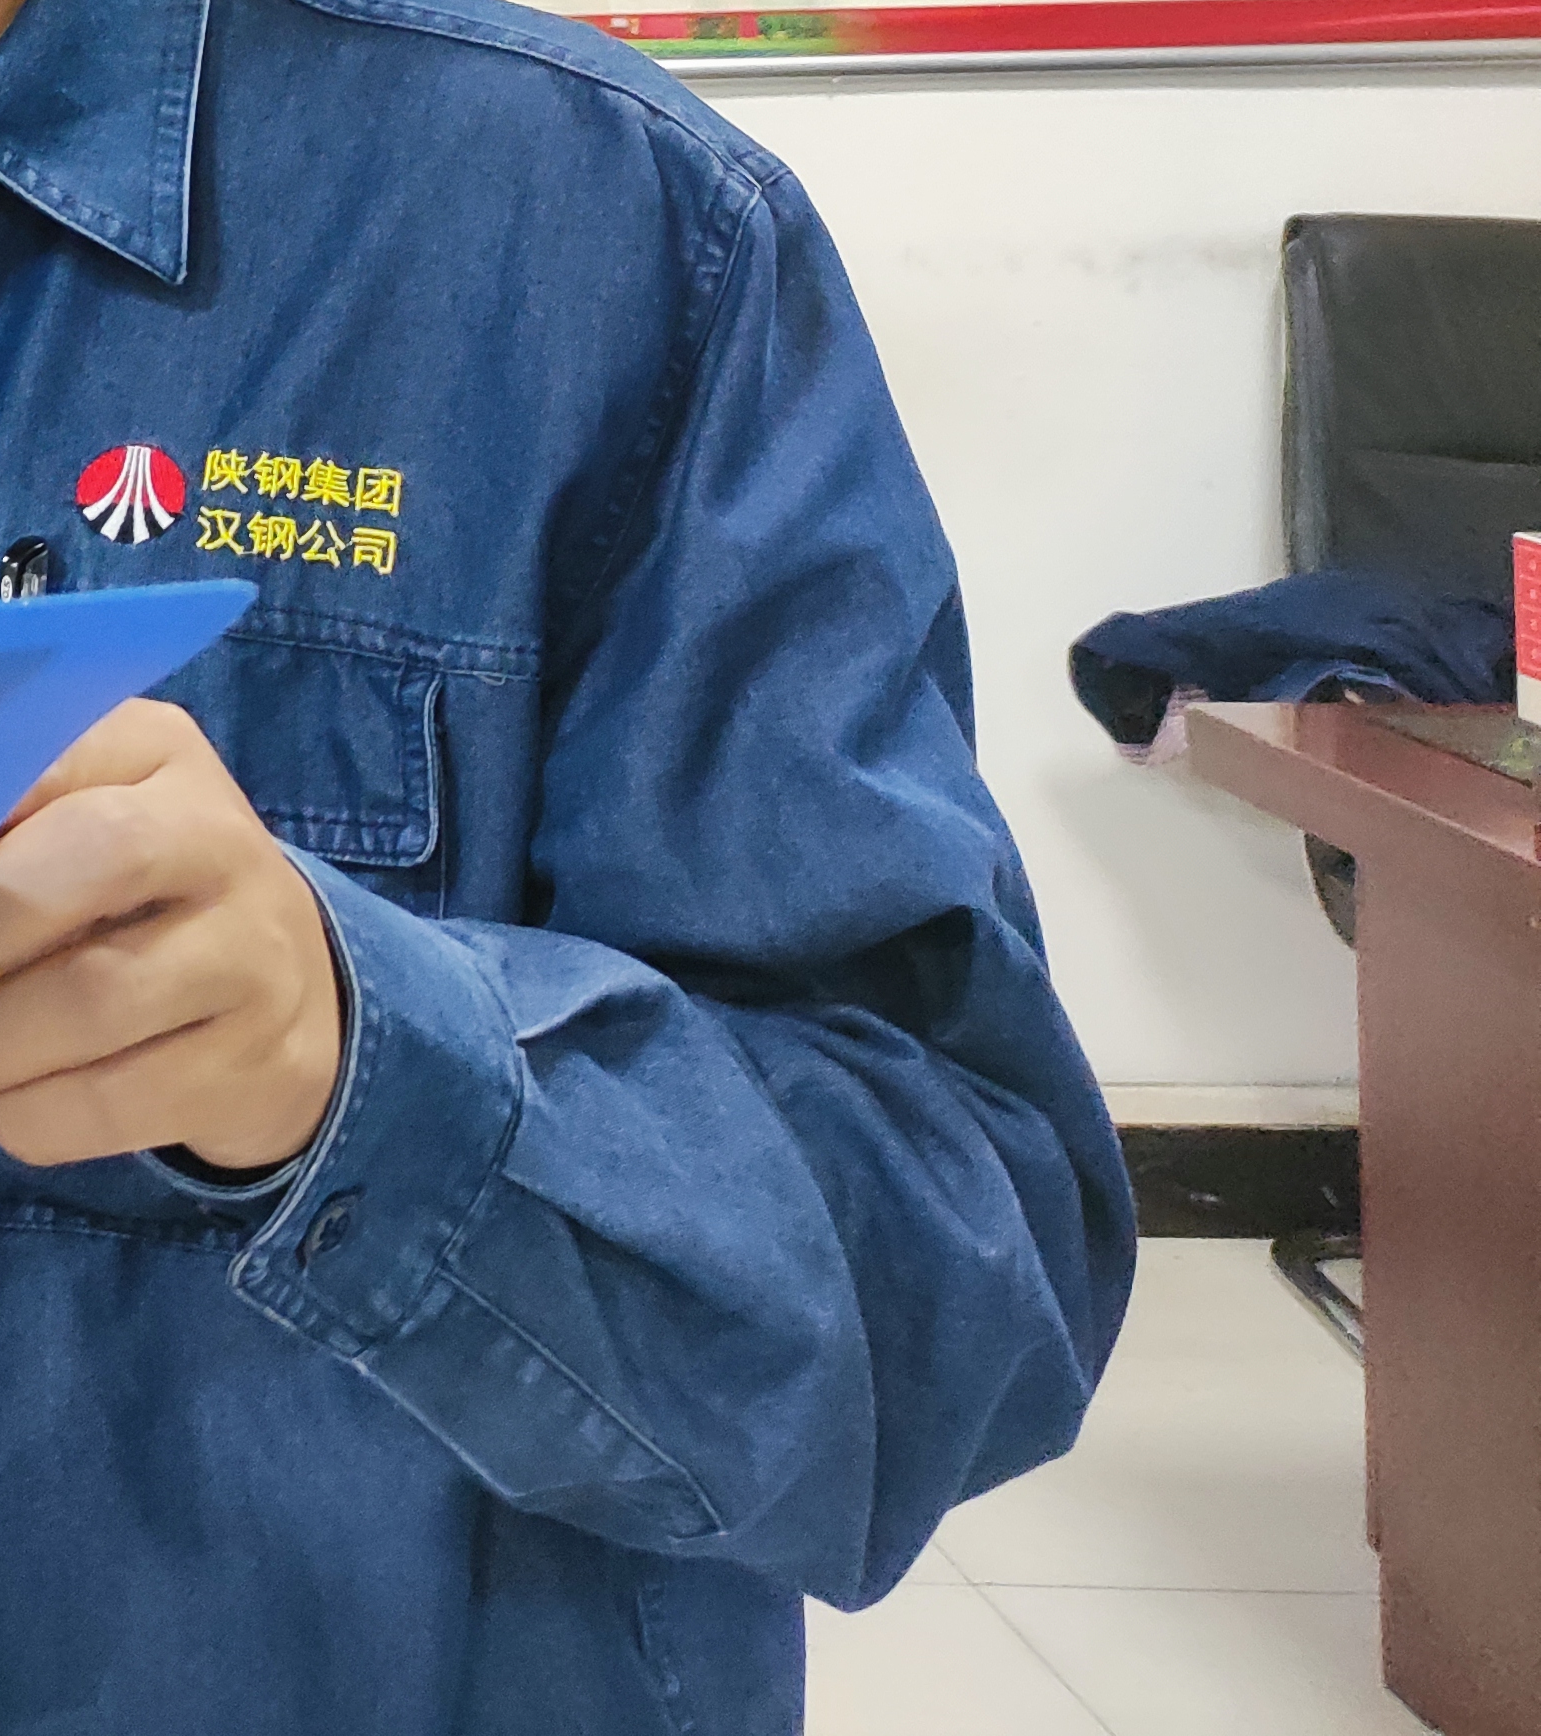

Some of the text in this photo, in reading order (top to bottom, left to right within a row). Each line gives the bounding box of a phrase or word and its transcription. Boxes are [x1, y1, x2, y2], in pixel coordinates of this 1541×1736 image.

[201, 447, 403, 517] 陕钢集团
[195, 505, 398, 576] 汉钢公司
